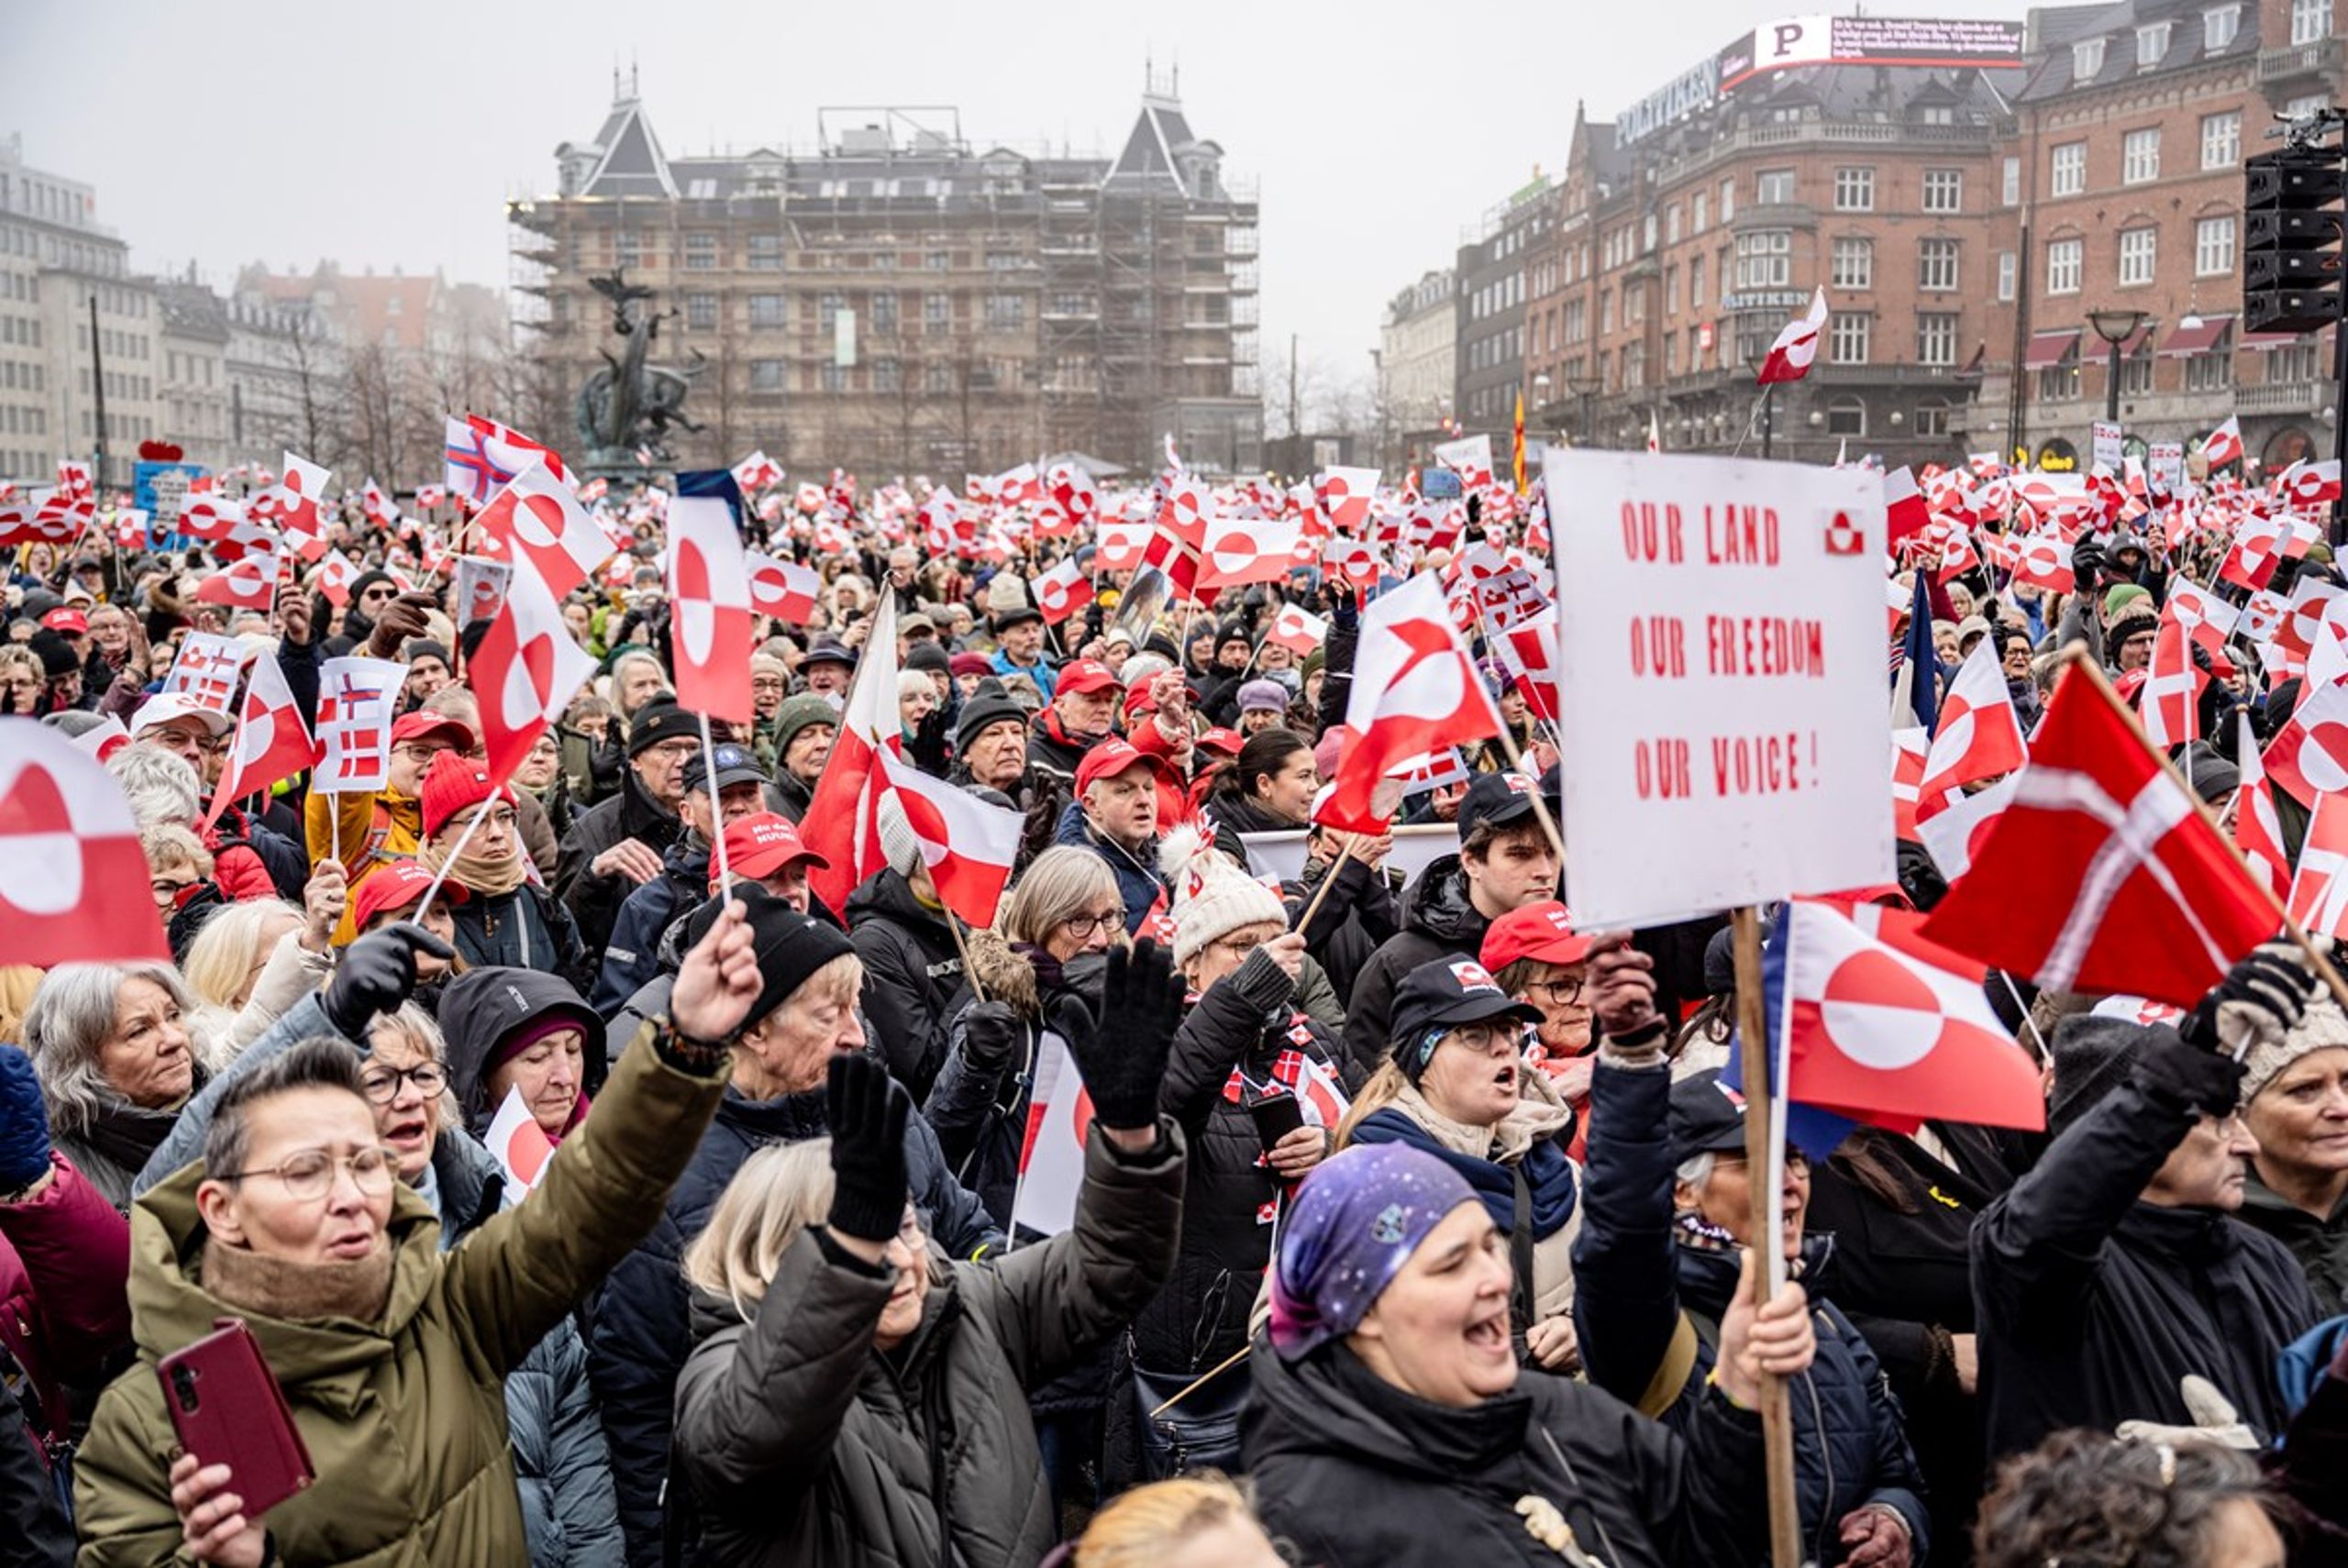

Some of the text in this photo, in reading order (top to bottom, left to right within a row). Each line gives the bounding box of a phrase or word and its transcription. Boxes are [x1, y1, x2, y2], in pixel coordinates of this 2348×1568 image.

[1773, 23, 1803, 56] P
[1621, 501, 1780, 566] OUR LAND
[1630, 615, 1825, 678] OUR FREEDOM
[1634, 738, 1690, 799] OUR
